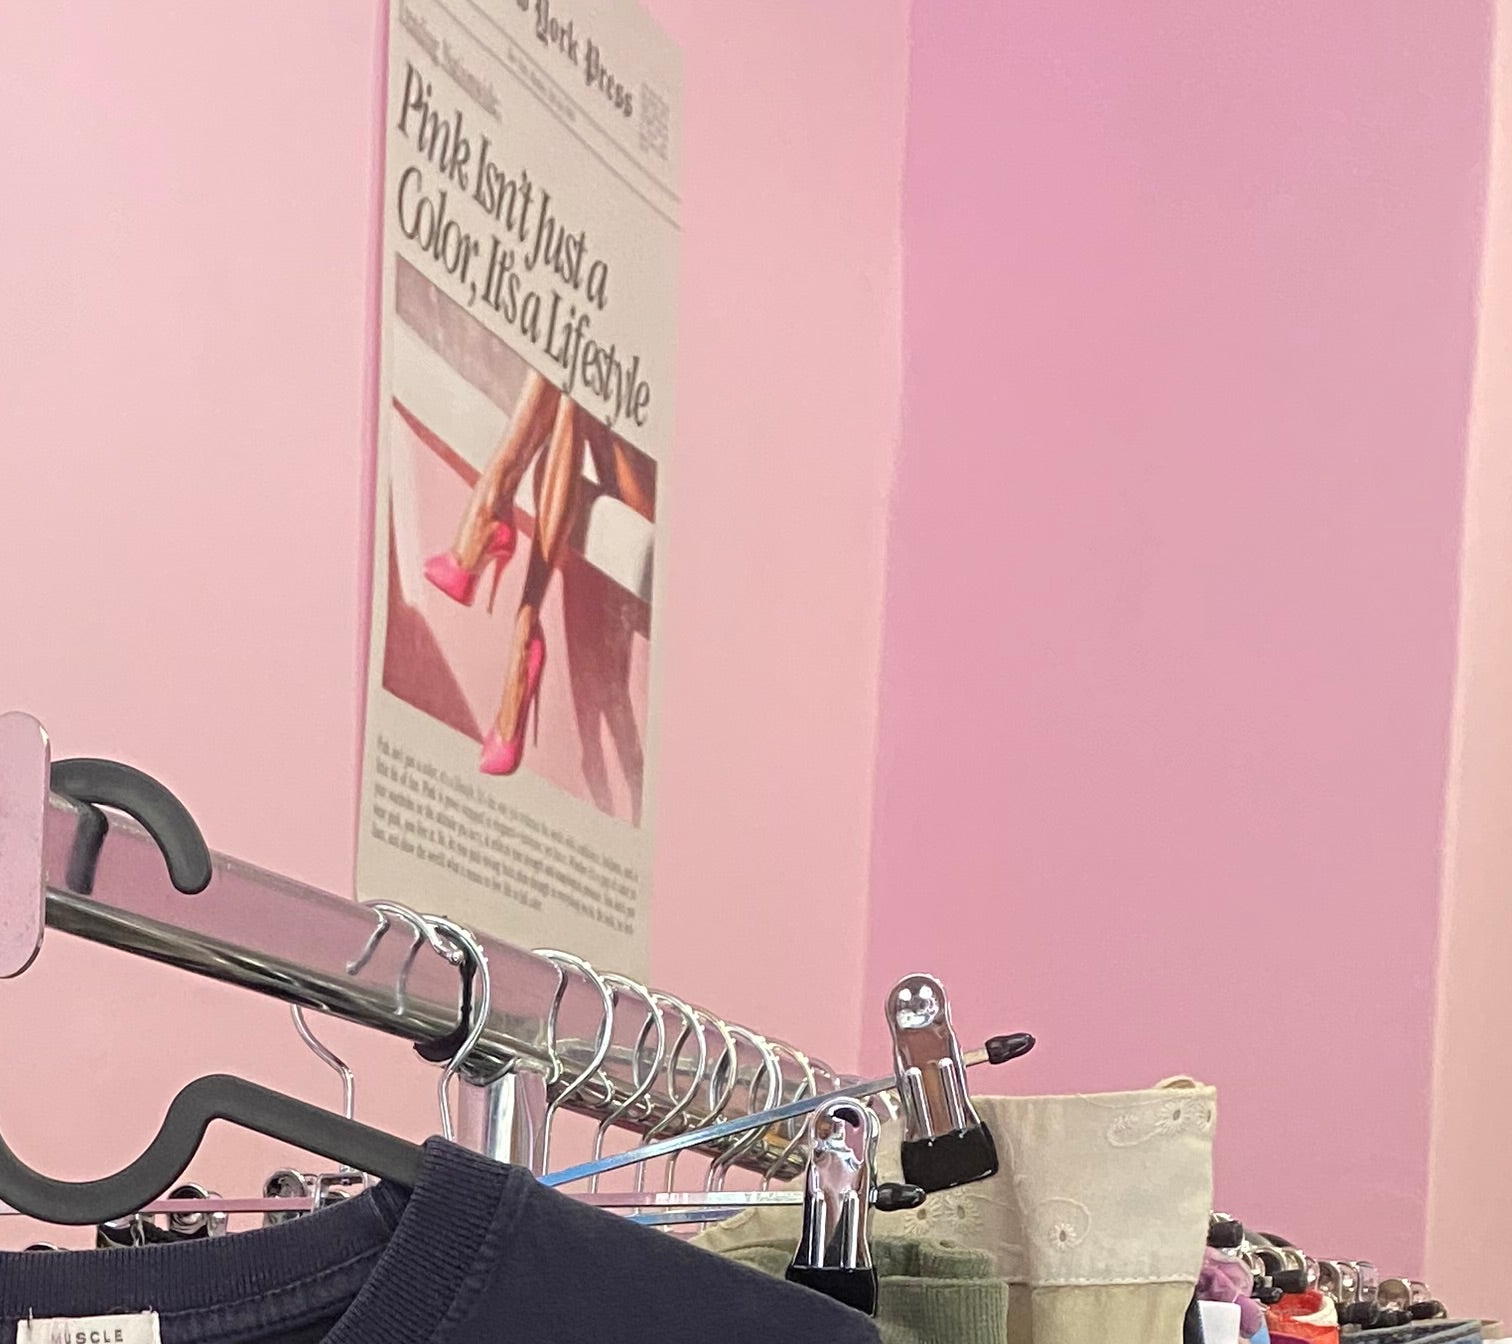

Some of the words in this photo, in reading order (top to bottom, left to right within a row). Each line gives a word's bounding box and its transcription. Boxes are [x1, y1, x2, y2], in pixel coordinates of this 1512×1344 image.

[397, 61, 471, 190] Pink
[472, 133, 533, 243] Isn't
[524, 188, 588, 291] Just
[587, 259, 609, 311] a
[585, 37, 633, 117] Press
[397, 165, 479, 307] Color,
[480, 233, 522, 325] It's
[521, 291, 542, 343] a
[543, 288, 651, 430] Lifestyle
